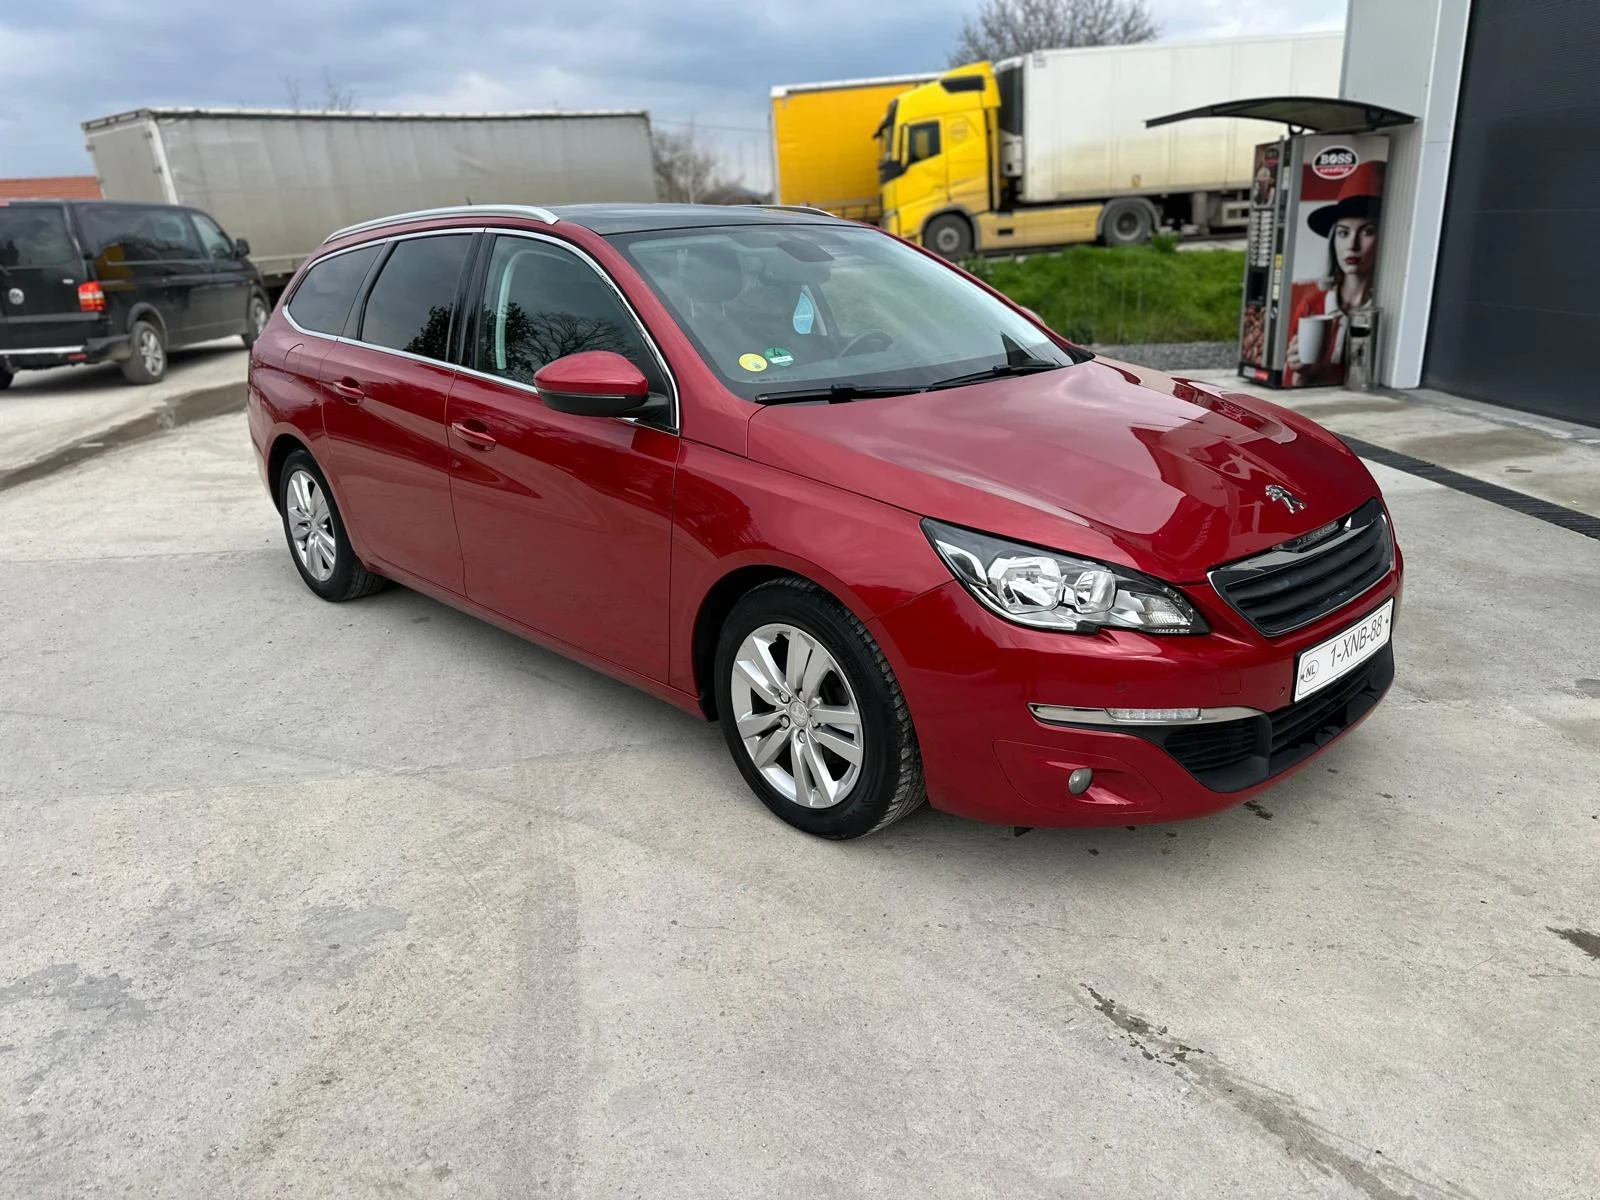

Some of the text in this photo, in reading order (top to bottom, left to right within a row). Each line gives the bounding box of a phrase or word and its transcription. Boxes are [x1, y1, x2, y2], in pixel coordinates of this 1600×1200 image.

[1320, 153, 1353, 165] BOSS
[1330, 615, 1382, 668] 1-XNB-88
[1306, 664, 1316, 678] NL
